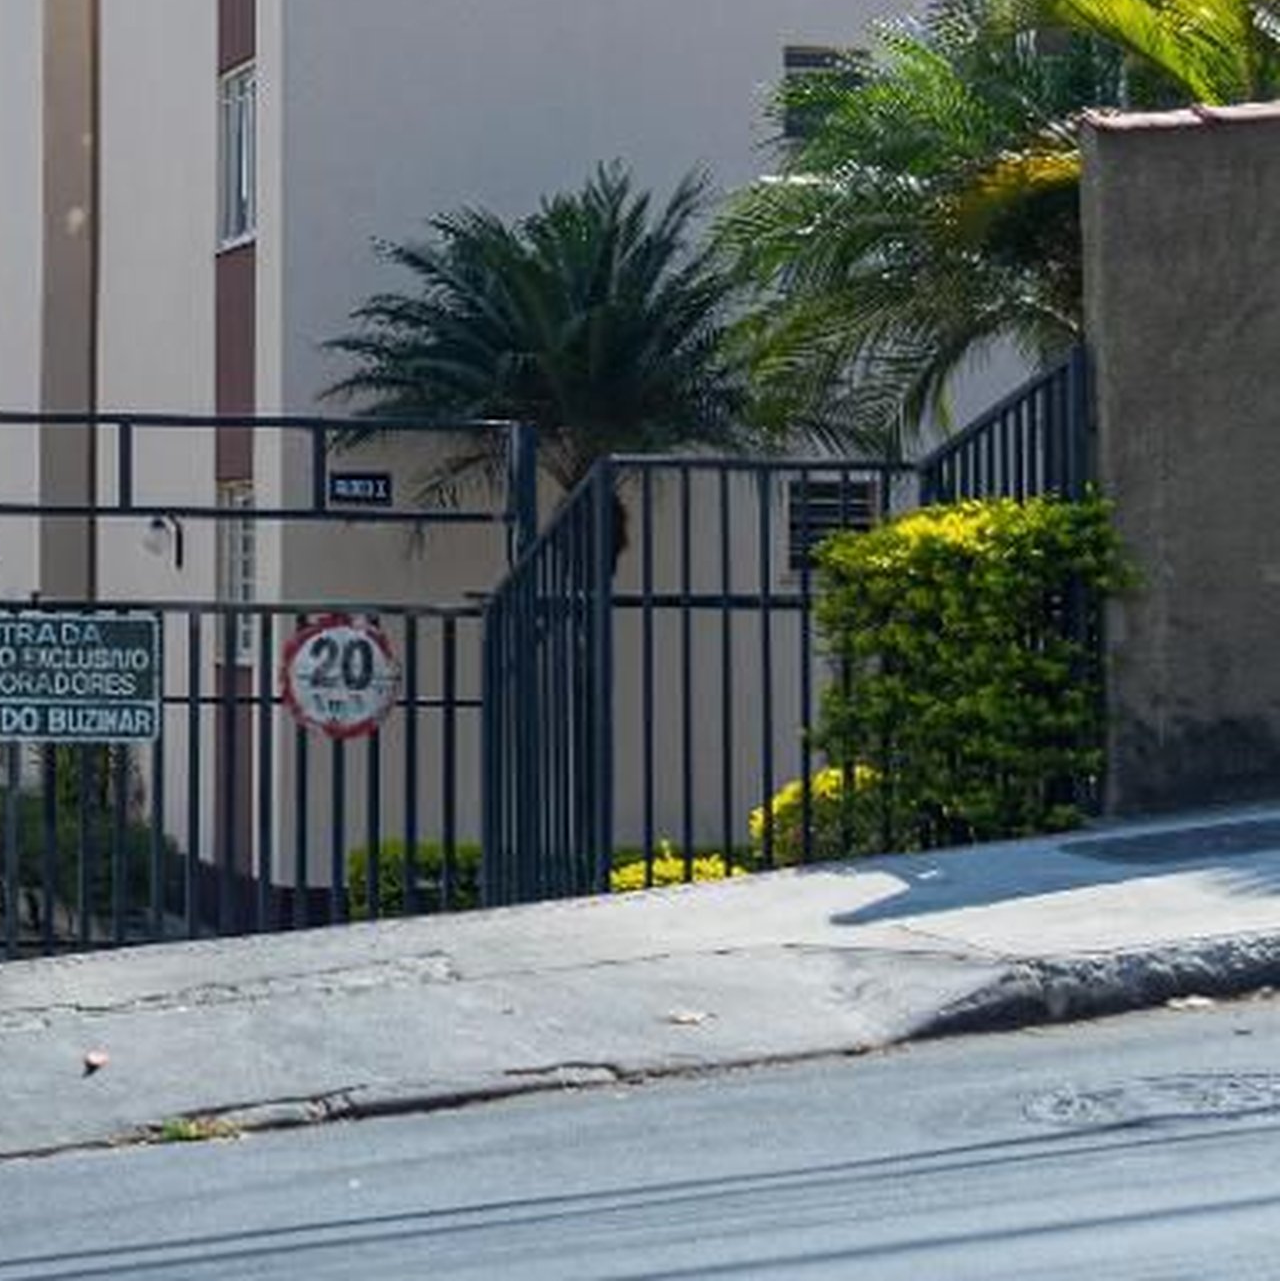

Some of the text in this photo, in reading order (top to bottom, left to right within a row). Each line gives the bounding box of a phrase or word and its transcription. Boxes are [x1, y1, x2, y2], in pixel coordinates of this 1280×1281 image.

[21, 646, 150, 670] EXCLUSIVO
[310, 636, 374, 691] 20
[48, 706, 152, 734] BUZINAR
